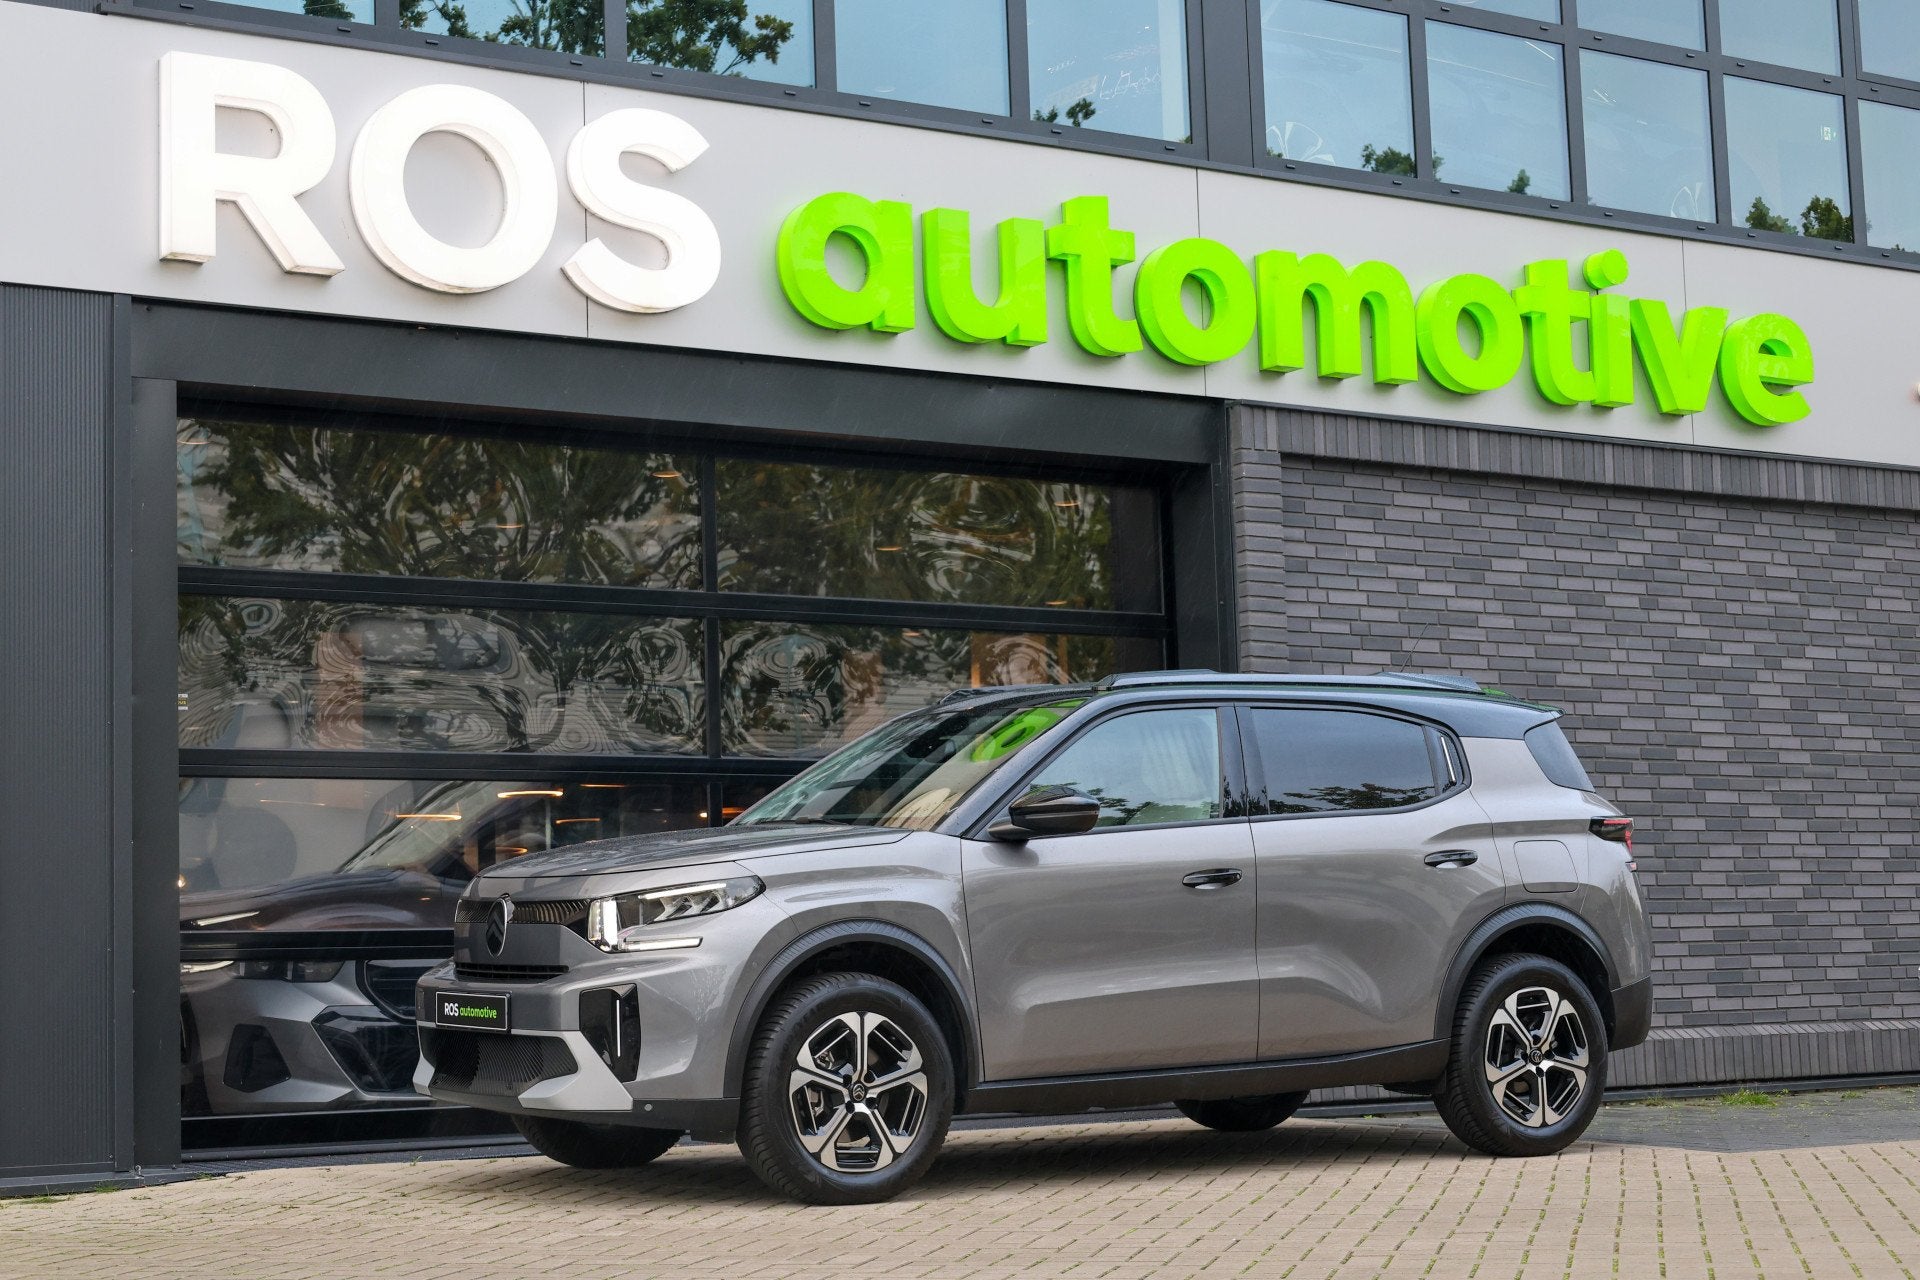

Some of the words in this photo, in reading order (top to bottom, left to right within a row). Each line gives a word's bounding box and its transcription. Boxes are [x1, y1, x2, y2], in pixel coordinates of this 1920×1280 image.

[158, 50, 721, 314] ROS
[775, 191, 1814, 427] automotive
[444, 1003, 459, 1016] ROS
[459, 1006, 497, 1018] automotive
